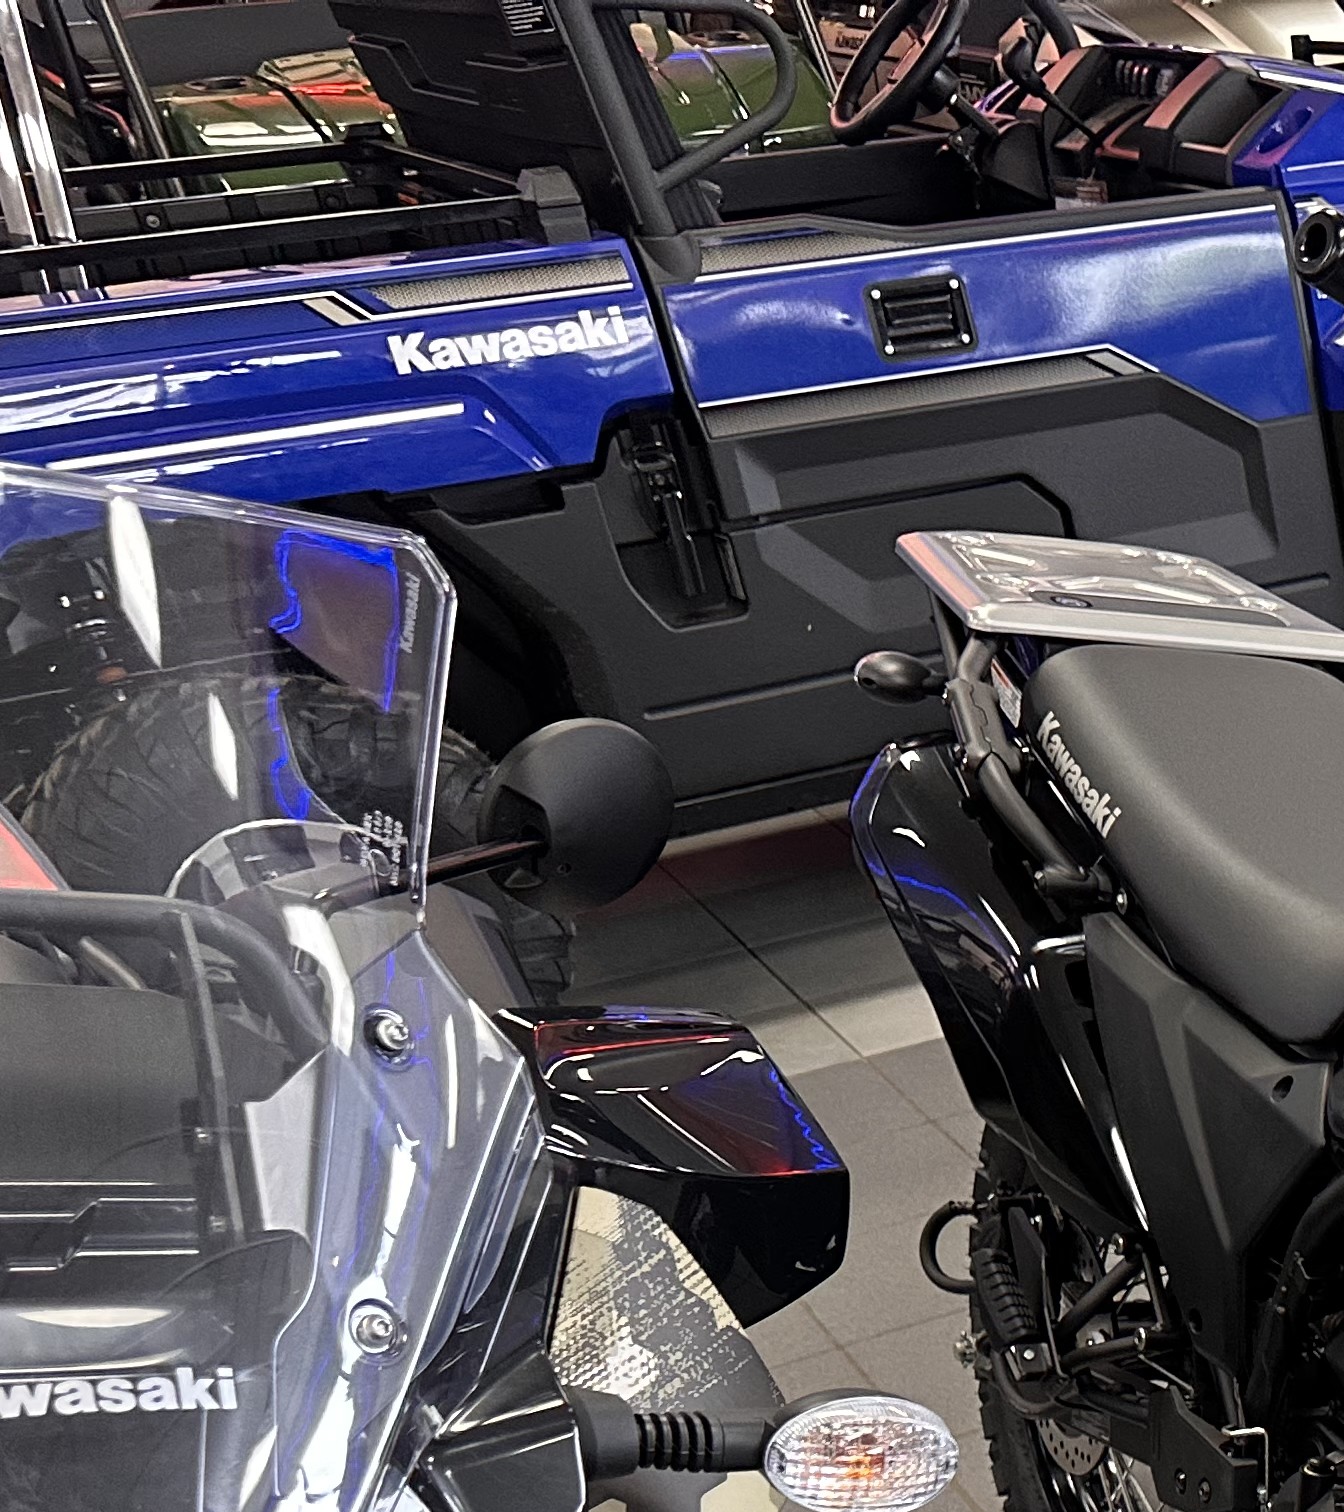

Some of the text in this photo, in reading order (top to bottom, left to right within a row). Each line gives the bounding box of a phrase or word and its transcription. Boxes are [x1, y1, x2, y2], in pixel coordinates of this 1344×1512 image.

[387, 305, 630, 375] Kawasaki
[400, 570, 421, 653] Kawasaki
[1036, 711, 1122, 839] Kawasaki
